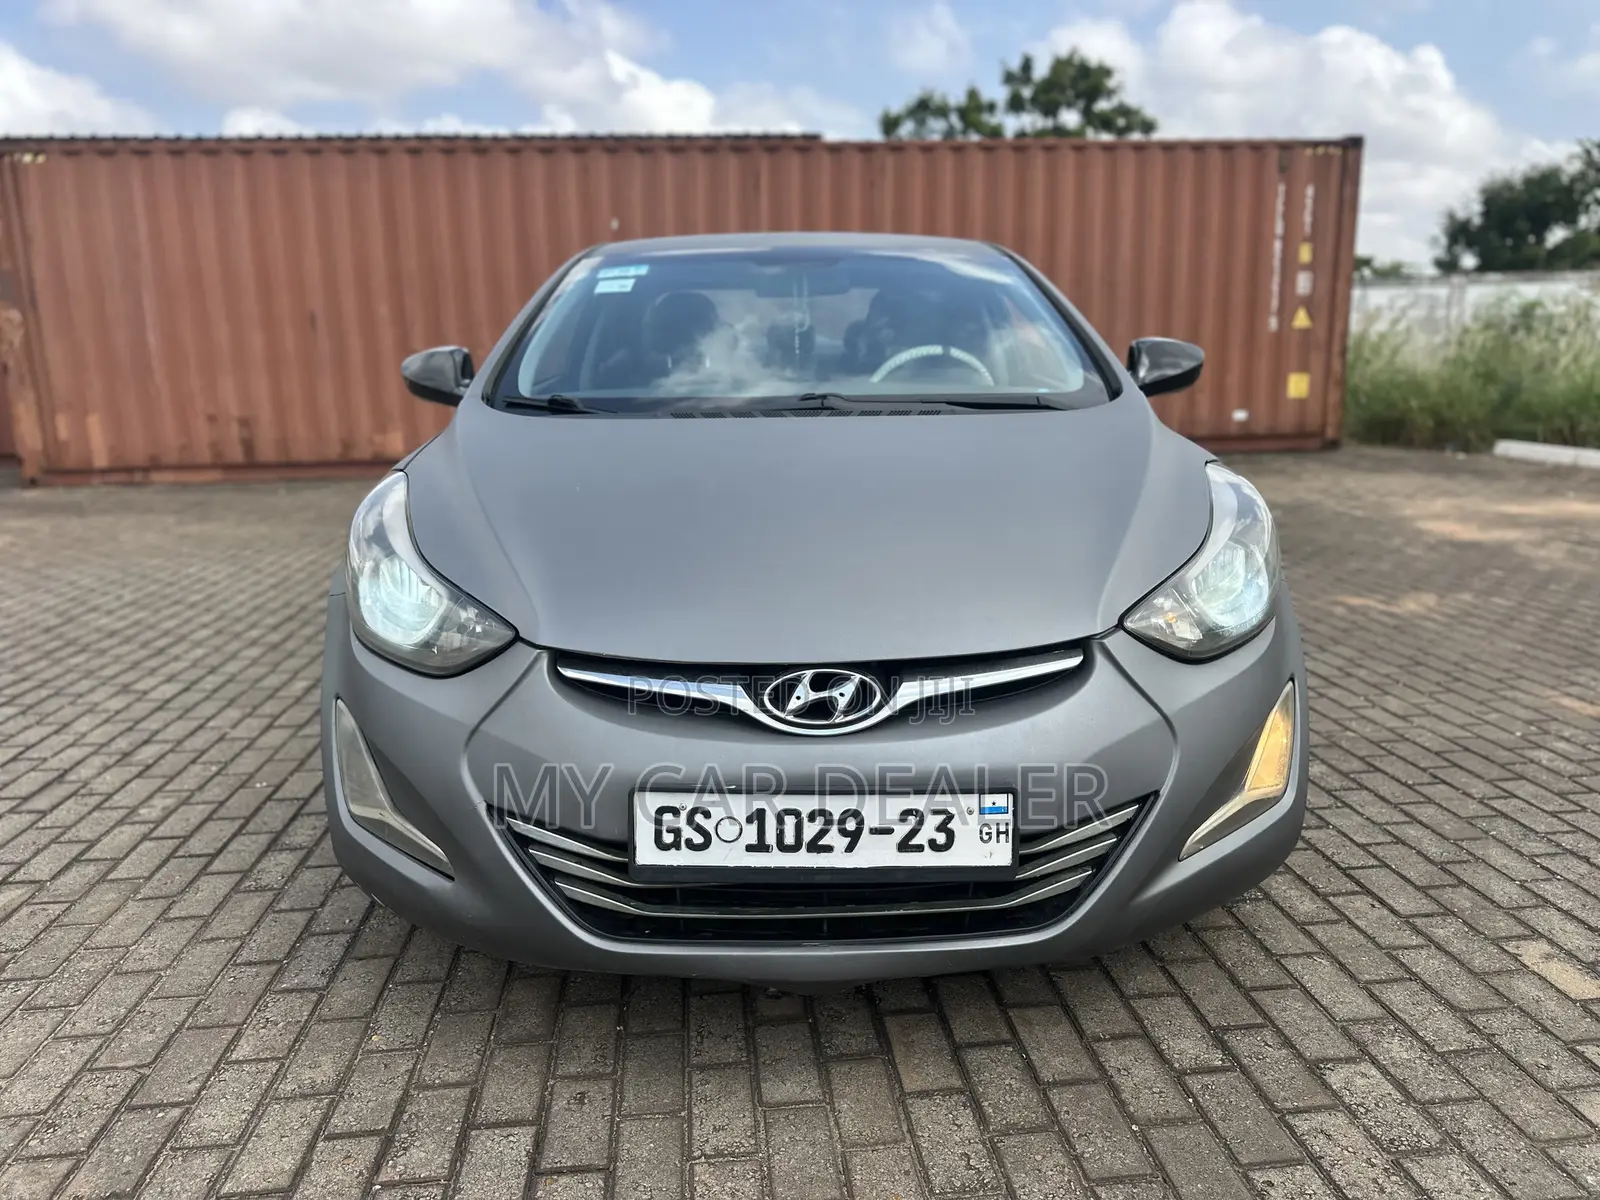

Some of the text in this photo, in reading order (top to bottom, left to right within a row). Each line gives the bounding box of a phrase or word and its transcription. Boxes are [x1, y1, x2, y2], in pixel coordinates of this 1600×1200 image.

[653, 805, 956, 854] GS 1029-23
[978, 822, 1010, 844] GH
